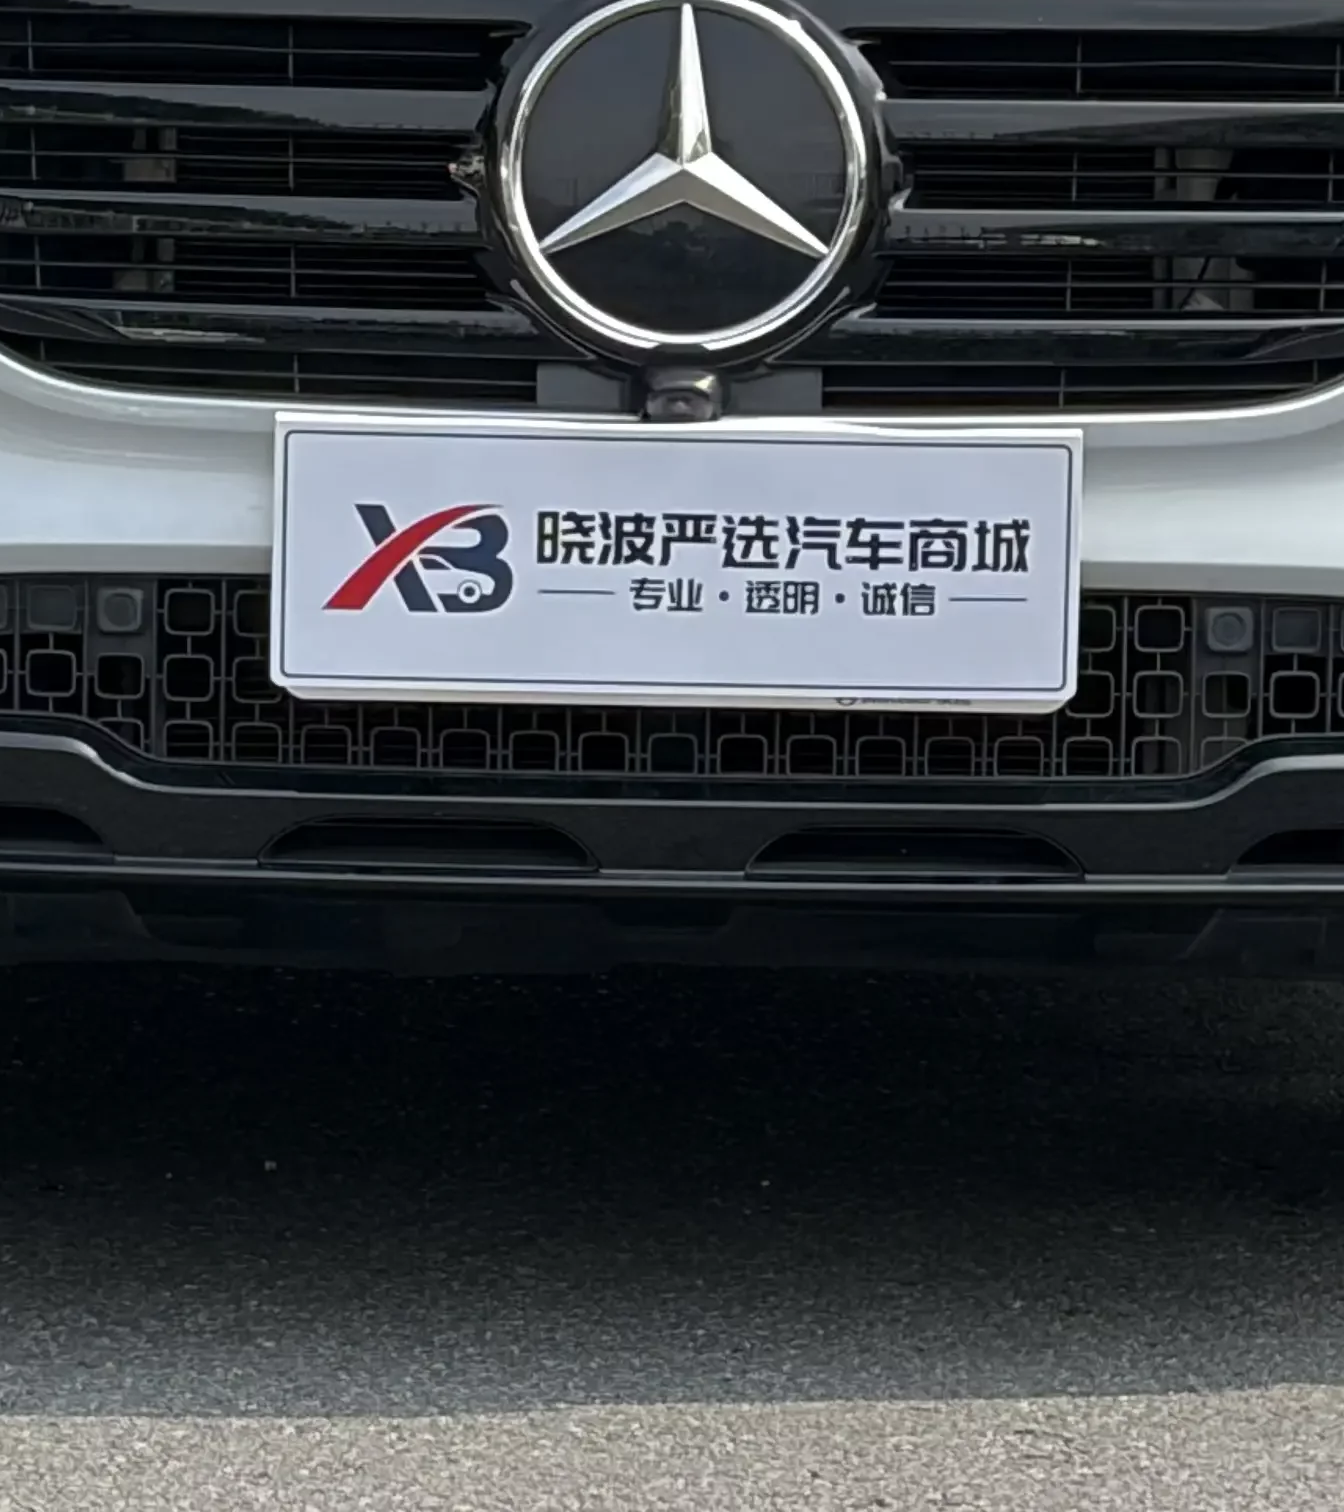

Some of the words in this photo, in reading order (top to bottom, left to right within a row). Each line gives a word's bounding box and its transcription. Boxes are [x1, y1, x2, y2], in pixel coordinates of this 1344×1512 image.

[536, 509, 1032, 575] 晓波严选汽车商城
